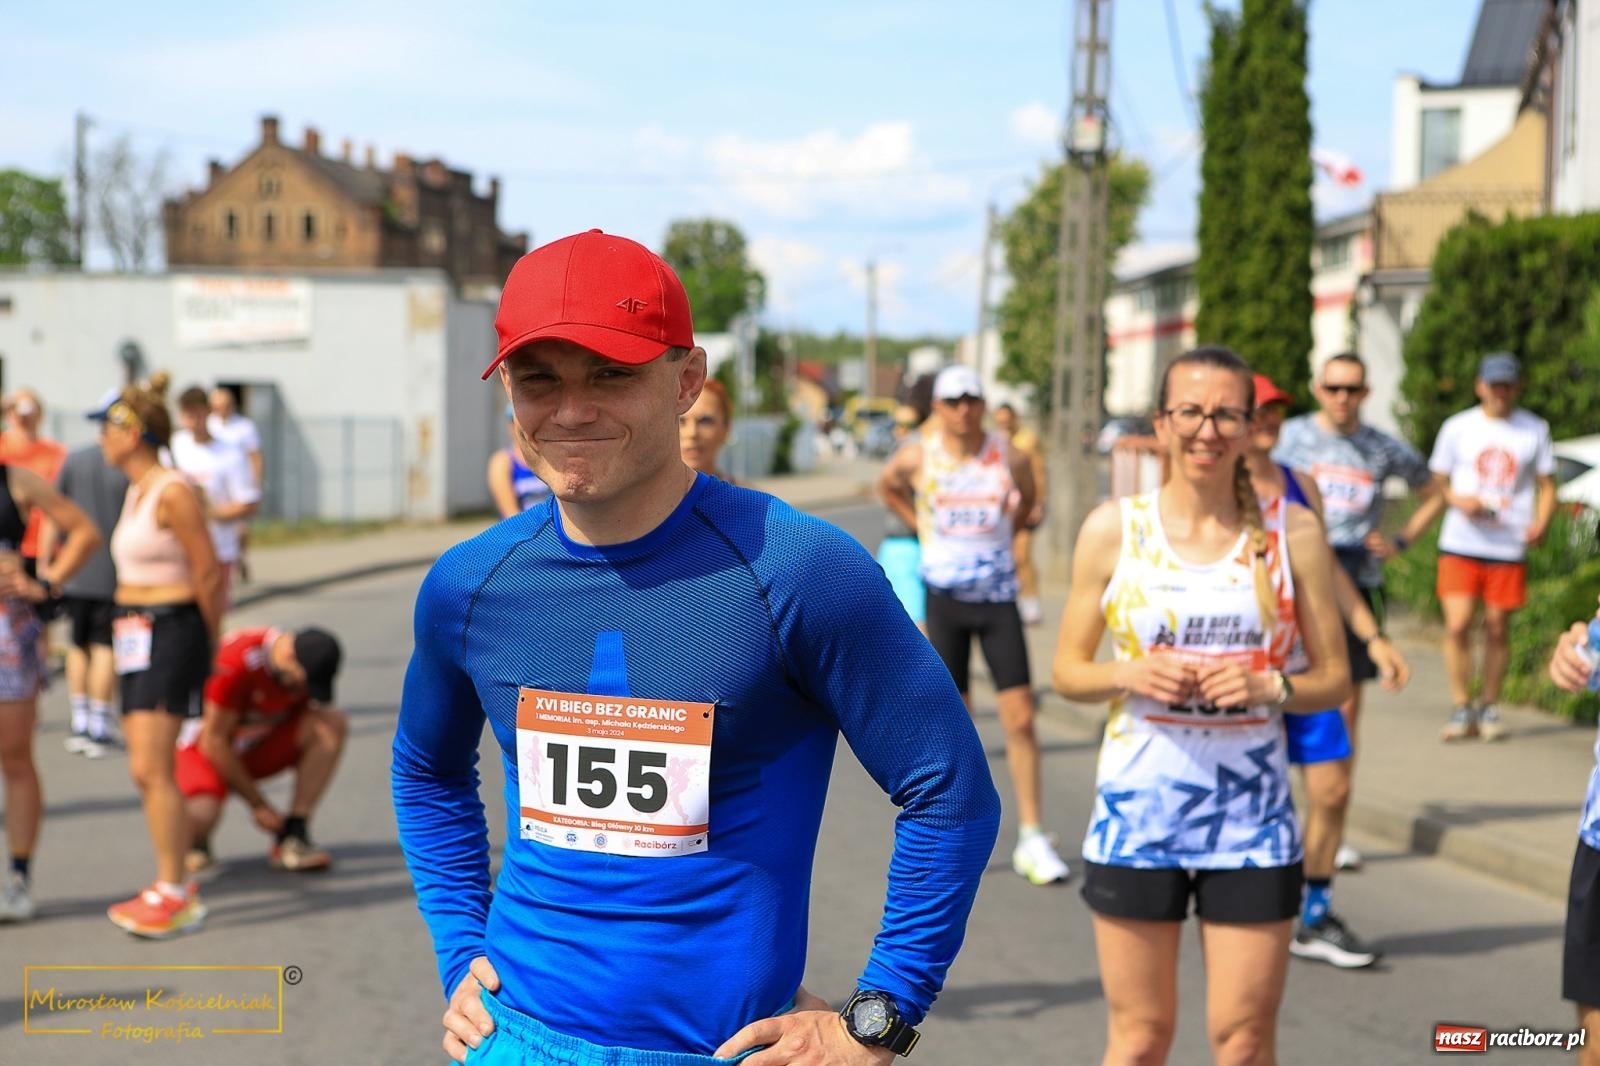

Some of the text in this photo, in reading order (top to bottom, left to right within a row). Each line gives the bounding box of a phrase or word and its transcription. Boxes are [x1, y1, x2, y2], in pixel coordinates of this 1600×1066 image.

[536, 697, 687, 721] XVI BIEG BEZ GRANIC
[632, 721, 685, 733] Kędzierskiego
[547, 743, 667, 813] 155
[553, 816, 590, 826] KATEGORIA:
[591, 820, 606, 830] Bieg
[634, 840, 677, 849] Racibórz
